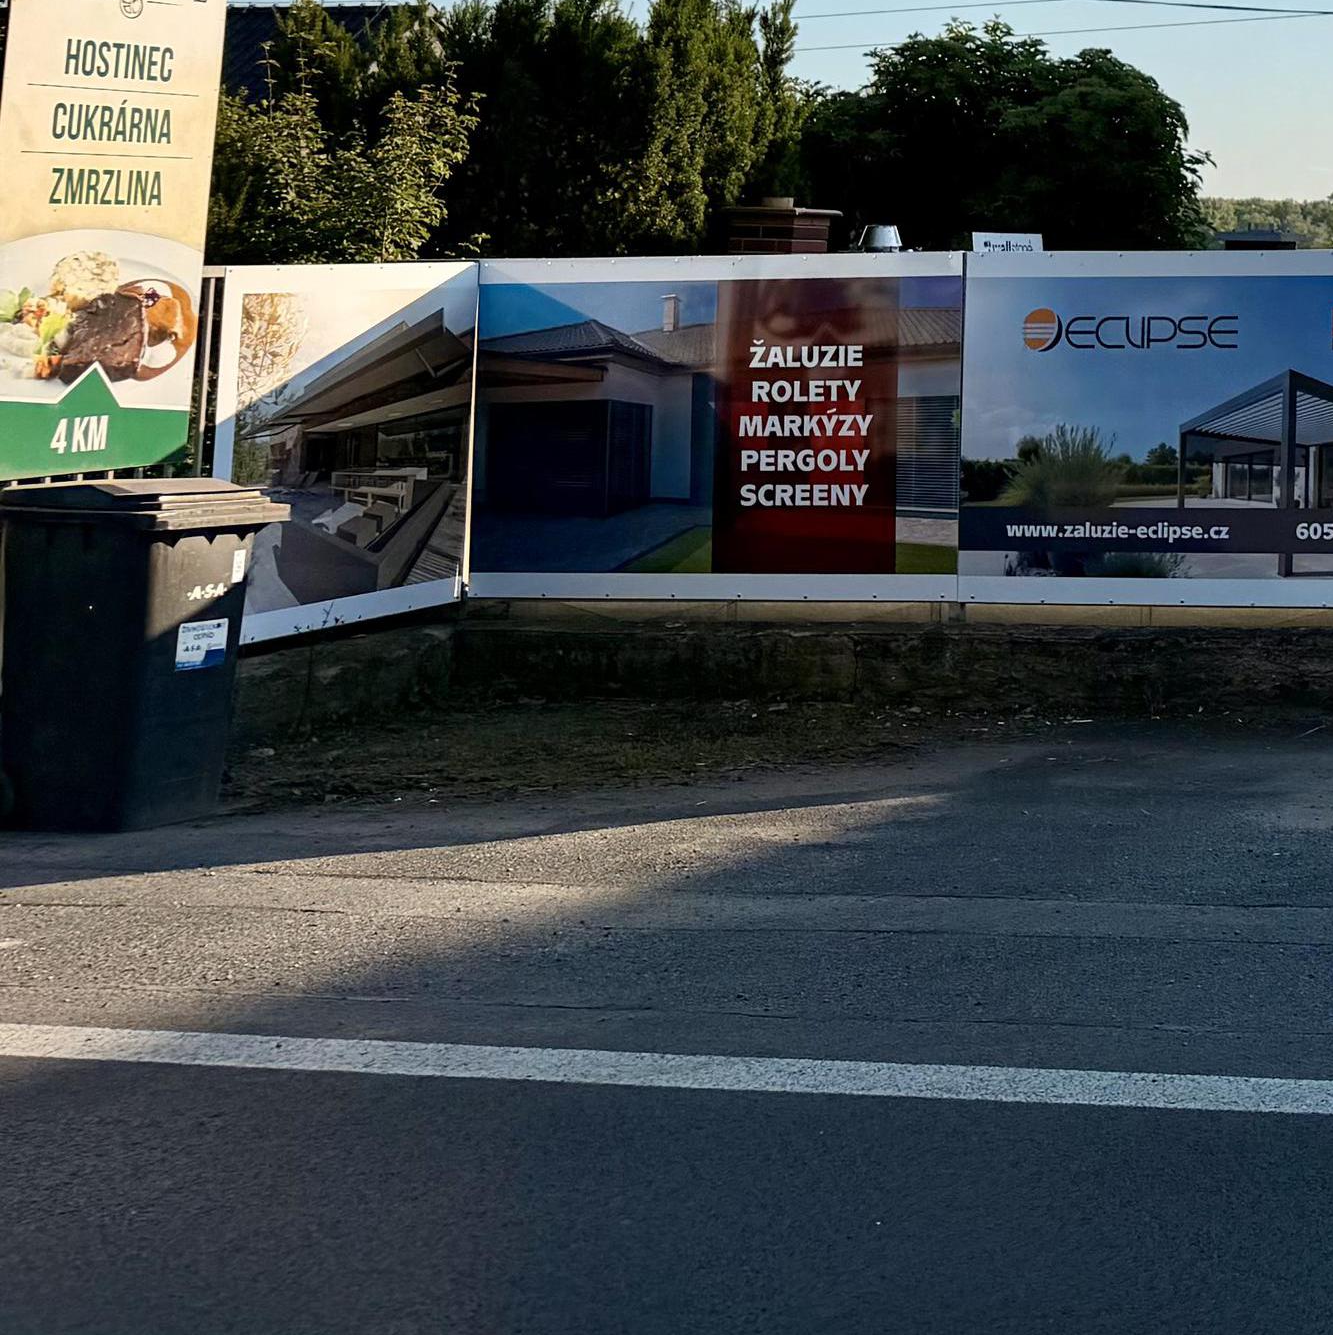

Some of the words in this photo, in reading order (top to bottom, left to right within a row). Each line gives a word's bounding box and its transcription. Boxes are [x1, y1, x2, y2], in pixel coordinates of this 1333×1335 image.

[64, 37, 174, 83] HOSTINEC
[51, 99, 172, 145] CUKRÁRNA
[48, 167, 162, 207] ZMRZLINA
[1064, 314, 1239, 350] ECLIPSE
[748, 338, 864, 369] ŽALUZIE
[751, 378, 862, 404] ROLETY
[50, 417, 67, 455] 4
[72, 414, 108, 453] KM
[738, 408, 874, 438] MARKÝZY
[740, 448, 871, 473] PERGOLY
[739, 483, 870, 508] SCREENY
[1006, 520, 1230, 543] www.zaluzie-eclipse.cz
